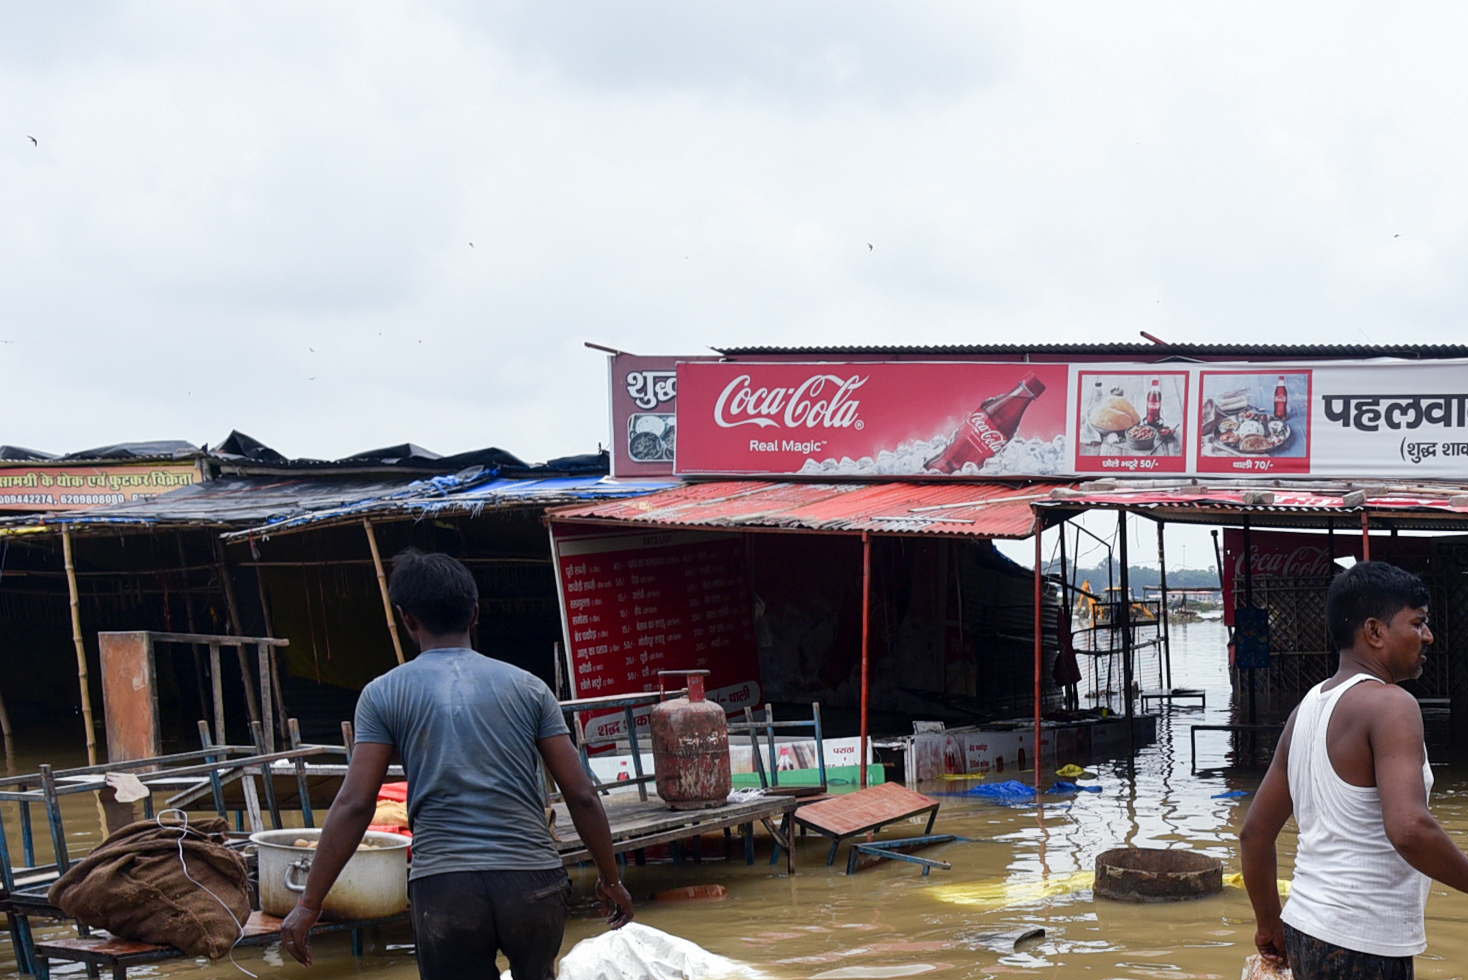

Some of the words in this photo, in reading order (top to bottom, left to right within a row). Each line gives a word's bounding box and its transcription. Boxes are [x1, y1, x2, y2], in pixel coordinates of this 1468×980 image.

[749, 440, 783, 453] Real
[1399, 436, 1436, 464] (शुद्ध
[1102, 459, 1119, 469] छोले
[1120, 459, 1138, 471] भटूरे
[1140, 460, 1159, 470] 50/-
[1233, 459, 1253, 470] थाली
[1255, 460, 1274, 470] 70/-
[40, 472, 54, 487] के
[57, 472, 84, 487] थोक
[87, 472, 108, 487] एवं
[110, 474, 150, 490] फुटकर
[151, 472, 194, 488] विक्रेता
